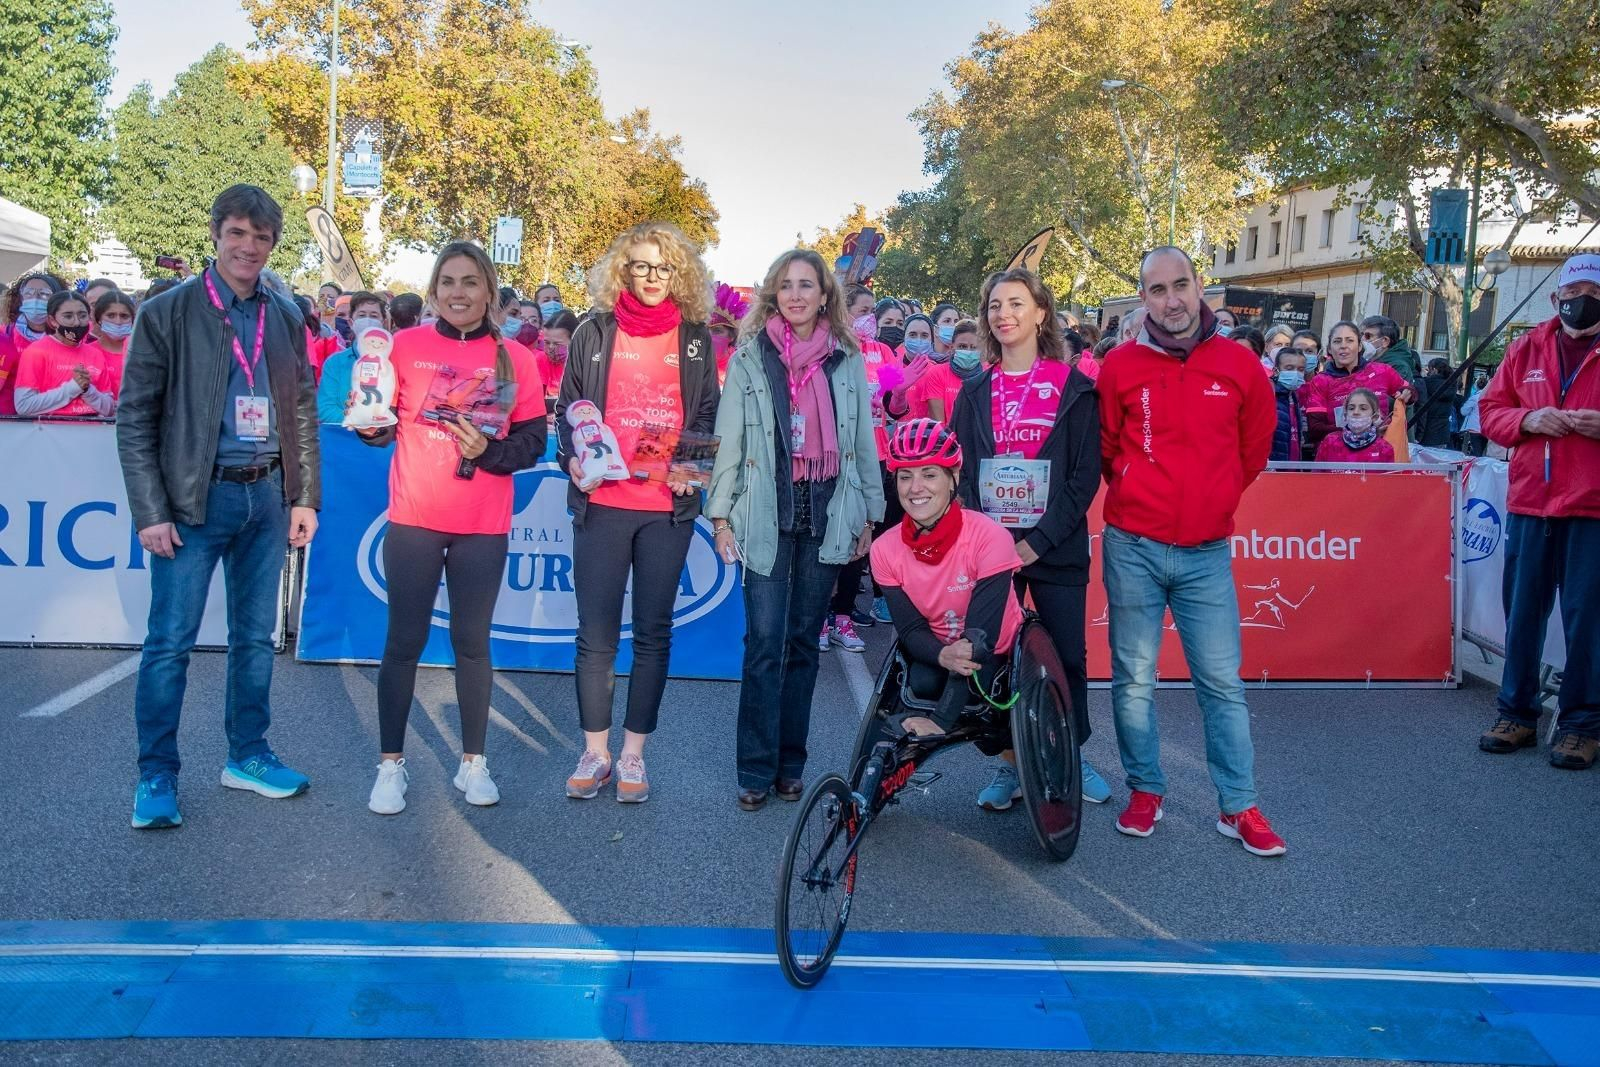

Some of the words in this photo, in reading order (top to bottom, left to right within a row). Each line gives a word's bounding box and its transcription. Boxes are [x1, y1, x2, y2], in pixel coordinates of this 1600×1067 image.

[1203, 389, 1229, 397] Santander
[645, 407, 676, 419] TODA
[994, 429, 1041, 442] URICH
[996, 486, 1027, 499] 016
